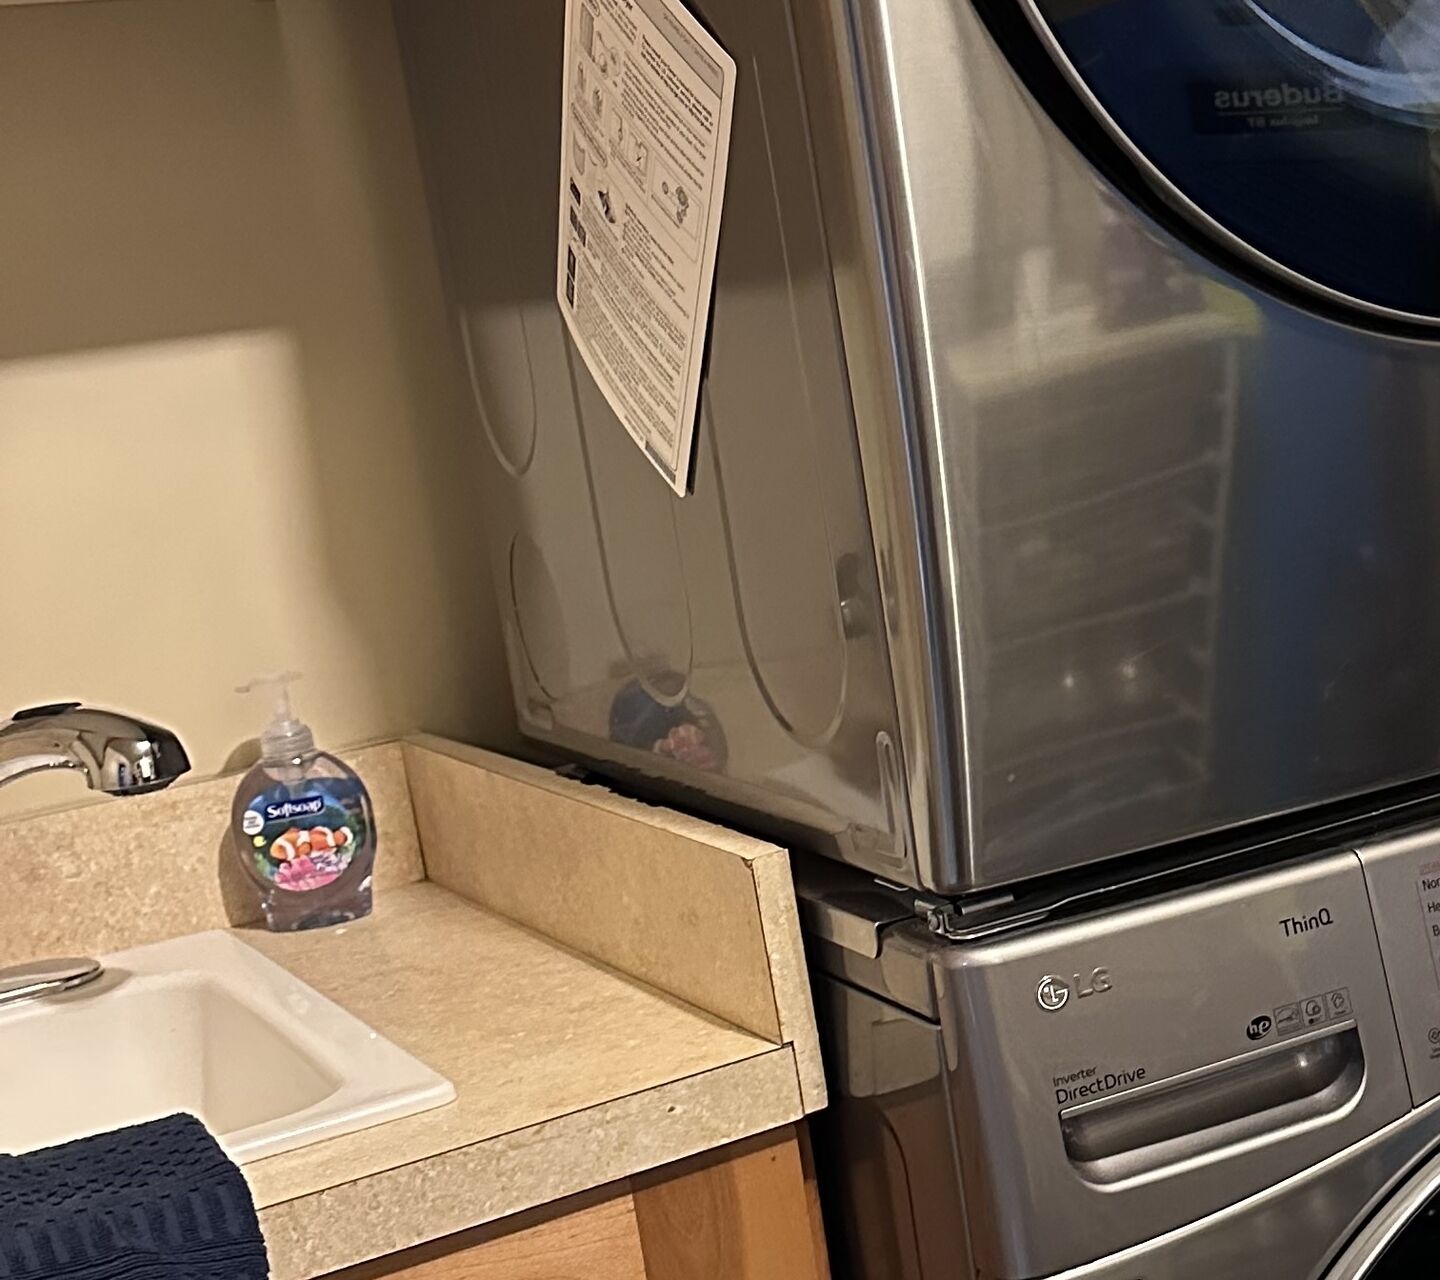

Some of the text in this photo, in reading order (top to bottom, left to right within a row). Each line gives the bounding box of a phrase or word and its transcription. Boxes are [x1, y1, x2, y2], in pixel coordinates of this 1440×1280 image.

[266, 798, 323, 818] Softsoap
[1279, 908, 1333, 937] ThinQ
[1073, 966, 1114, 999] LG
[1052, 1066, 1097, 1087] Inverter
